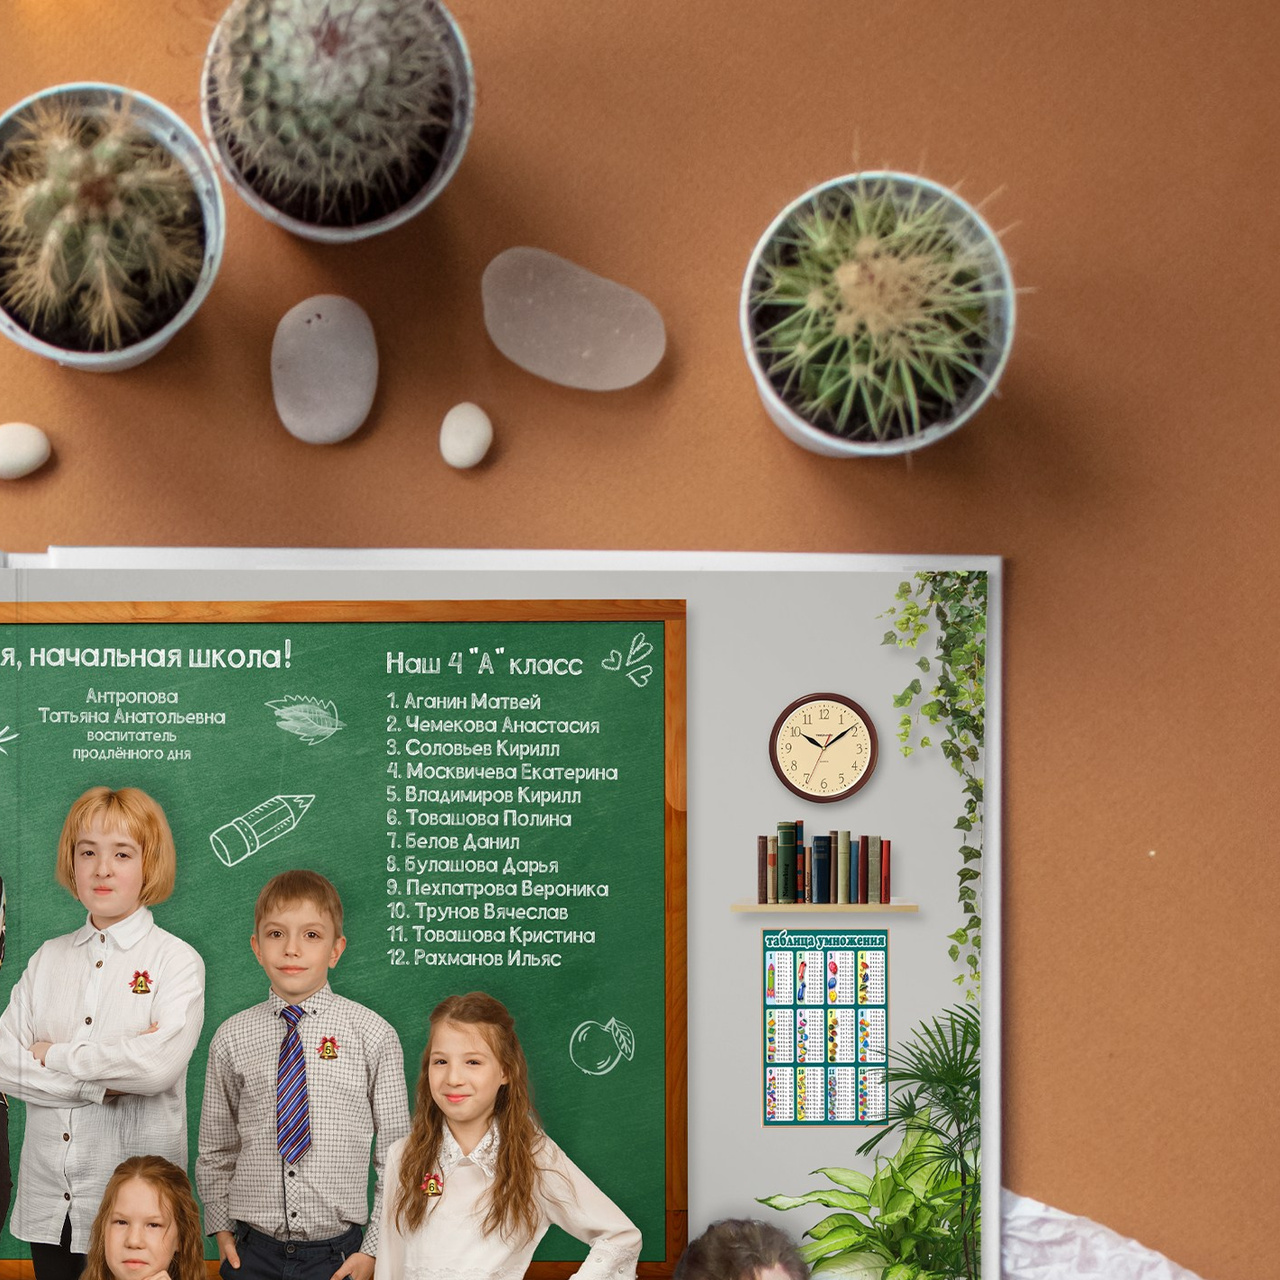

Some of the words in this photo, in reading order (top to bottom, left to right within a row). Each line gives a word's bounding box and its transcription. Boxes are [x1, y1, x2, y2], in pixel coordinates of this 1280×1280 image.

[30, 647, 182, 667] начальная
[188, 639, 292, 669] школа!
[386, 651, 441, 674] Наш
[448, 652, 463, 674] 4
[509, 658, 584, 675] класс
[86, 688, 179, 707] Антропова
[387, 692, 400, 709] 1.
[405, 692, 467, 709] Аганин
[471, 693, 541, 710] Матвей
[38, 707, 110, 724] Татьяна
[113, 708, 226, 724] Анатольевна
[802, 714, 812, 725] 11
[819, 708, 830, 720] 12
[838, 714, 844, 725] 1
[387, 715, 402, 732] 2.
[406, 715, 497, 732] Чемекова
[502, 716, 600, 734] Анастасия
[790, 726, 801, 737] 10
[87, 731, 177, 742] воспитатель
[73, 747, 164, 762] продлённого
[167, 750, 192, 761] дня
[387, 739, 402, 756] 3.
[406, 739, 492, 756] Соловьев
[496, 740, 560, 760] Кирилл
[785, 742, 792, 754] 9
[856, 743, 863, 755] 3
[387, 762, 402, 779] 4.
[406, 762, 517, 779] Москвичева
[521, 763, 618, 783] Екатерина
[790, 760, 798, 771] 8
[851, 760, 858, 771] 4
[820, 778, 828, 789] 6
[838, 773, 845, 784] 5
[387, 785, 402, 802] 5.
[405, 785, 514, 805] Владимиров
[518, 787, 581, 805] Кирилл
[387, 809, 402, 826] 6.
[406, 809, 499, 826] Товашова
[503, 810, 572, 827] Полина
[387, 832, 402, 849] 7.
[405, 832, 459, 849] Белов
[463, 833, 520, 851] Данил
[387, 855, 401, 872] 8.
[405, 855, 498, 874] Булашова
[502, 857, 559, 876] Дарья
[387, 879, 402, 896] 9.
[406, 879, 518, 899] Пехпатрова
[521, 880, 609, 899] Вероника
[387, 902, 410, 919] 10.
[414, 902, 480, 922] Трунов
[483, 903, 569, 920] Вячеслав
[387, 925, 408, 942] 11.
[412, 925, 506, 943] Товашова
[509, 927, 596, 945] Кристина
[765, 930, 815, 948] таблица
[817, 935, 886, 950] умножения
[387, 949, 410, 966] 12.
[414, 949, 504, 966] Рахманов
[507, 950, 562, 967] Ильяс
[137, 980, 145, 989] 4
[325, 1046, 332, 1055] 5
[428, 1183, 436, 1192] 6
